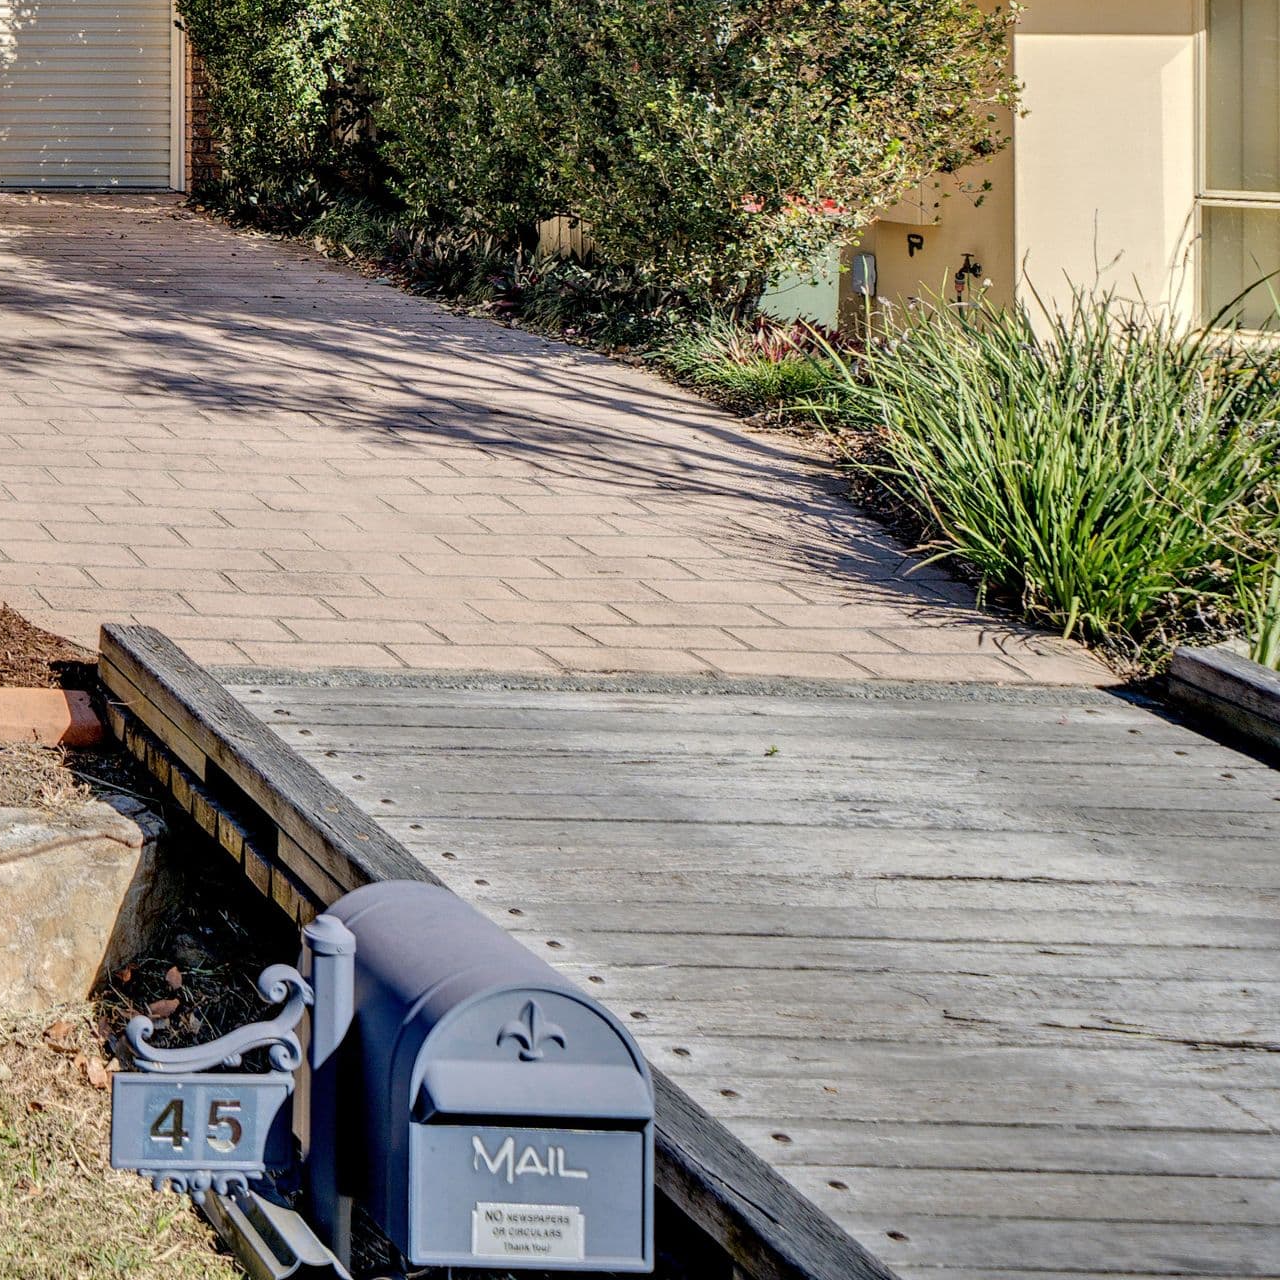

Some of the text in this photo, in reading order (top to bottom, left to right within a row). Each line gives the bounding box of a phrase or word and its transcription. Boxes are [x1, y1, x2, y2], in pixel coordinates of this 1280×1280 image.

[149, 1098, 243, 1153] 45
[471, 1135, 589, 1185] MAIL
[485, 1210, 570, 1224] NO NEWSPAPERS
[492, 1227, 562, 1238] OR CIRCULARS
